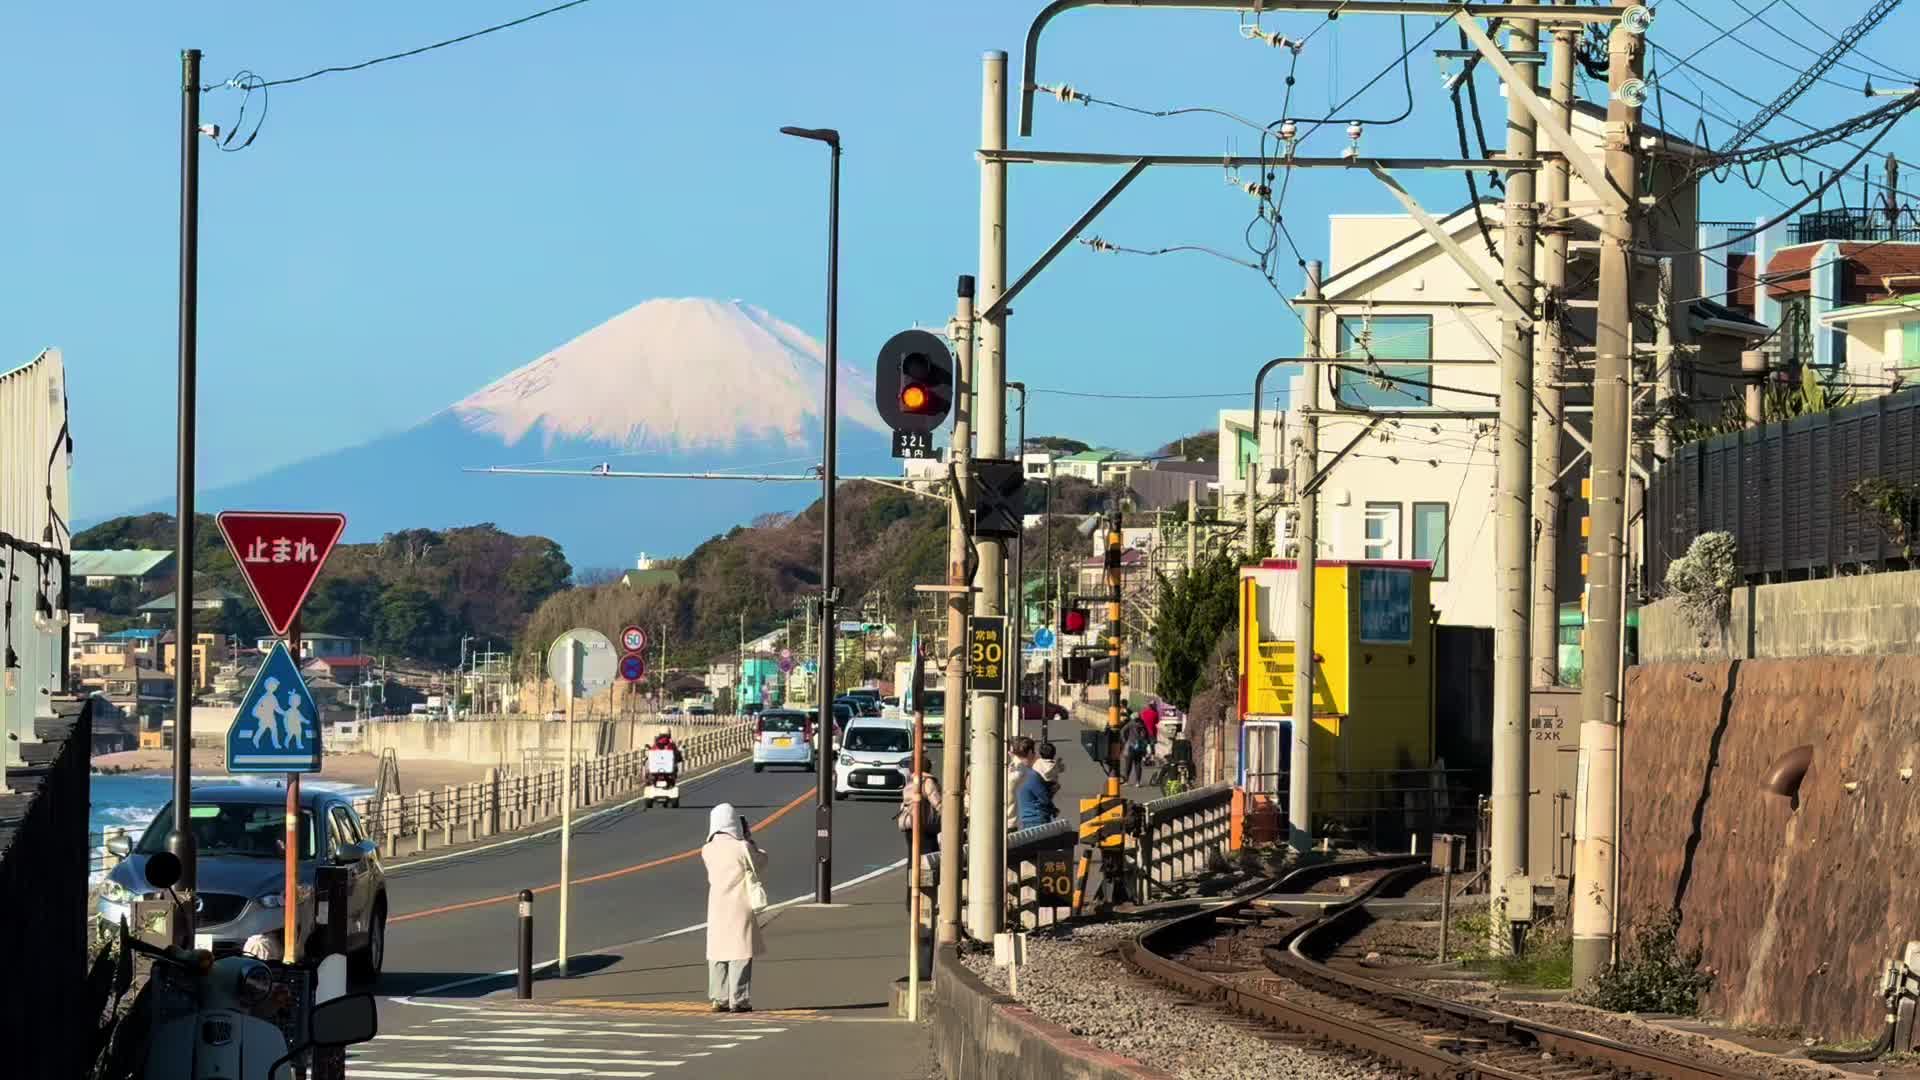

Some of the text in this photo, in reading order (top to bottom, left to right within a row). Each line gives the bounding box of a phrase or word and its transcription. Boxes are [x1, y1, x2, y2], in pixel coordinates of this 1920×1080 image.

[901, 434, 925, 447] 32L
[244, 536, 318, 563] 止まれ
[627, 634, 641, 646] 50
[976, 630, 998, 641] 常時
[973, 642, 1002, 662] 30
[972, 664, 999, 679] 注意
[1535, 731, 1561, 741] 2XK
[1041, 875, 1071, 896] 30
